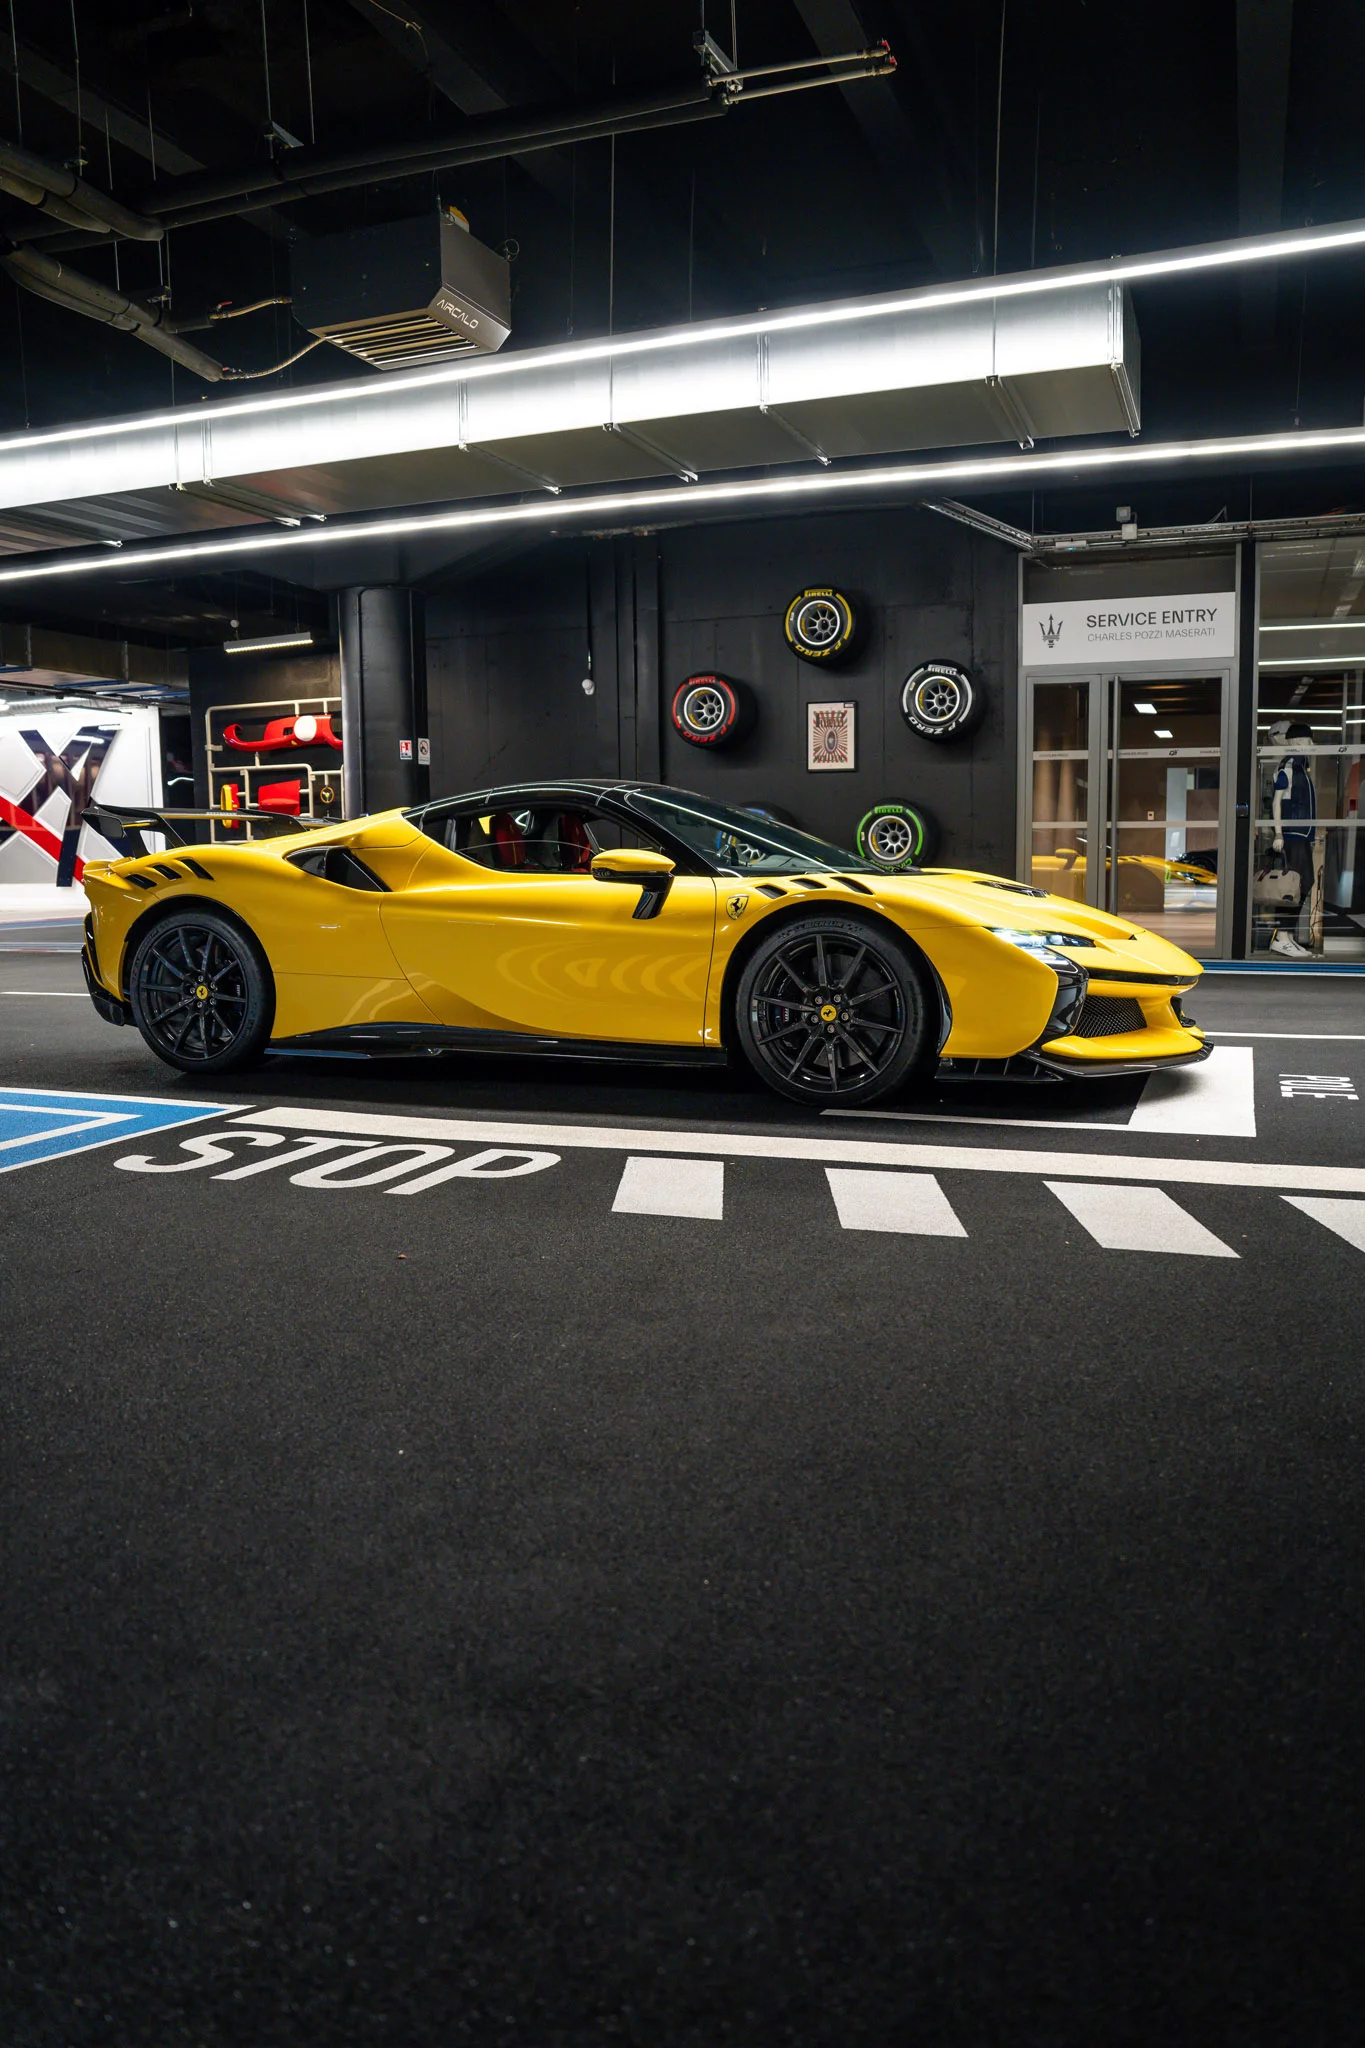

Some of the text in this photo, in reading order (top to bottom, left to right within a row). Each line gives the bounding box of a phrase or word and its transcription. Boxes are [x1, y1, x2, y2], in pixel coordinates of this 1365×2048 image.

[436, 299, 479, 329] AIRCALO
[1086, 608, 1218, 628] SERVICE ENTRY
[1087, 627, 1216, 642] CHARLES POZZI MASERATI
[796, 644, 831, 657] ZERO
[928, 664, 957, 676] PIRELLI
[909, 716, 944, 734] ZERO
[1278, 1073, 1360, 1100] POLE
[113, 1130, 562, 1195] STOP
